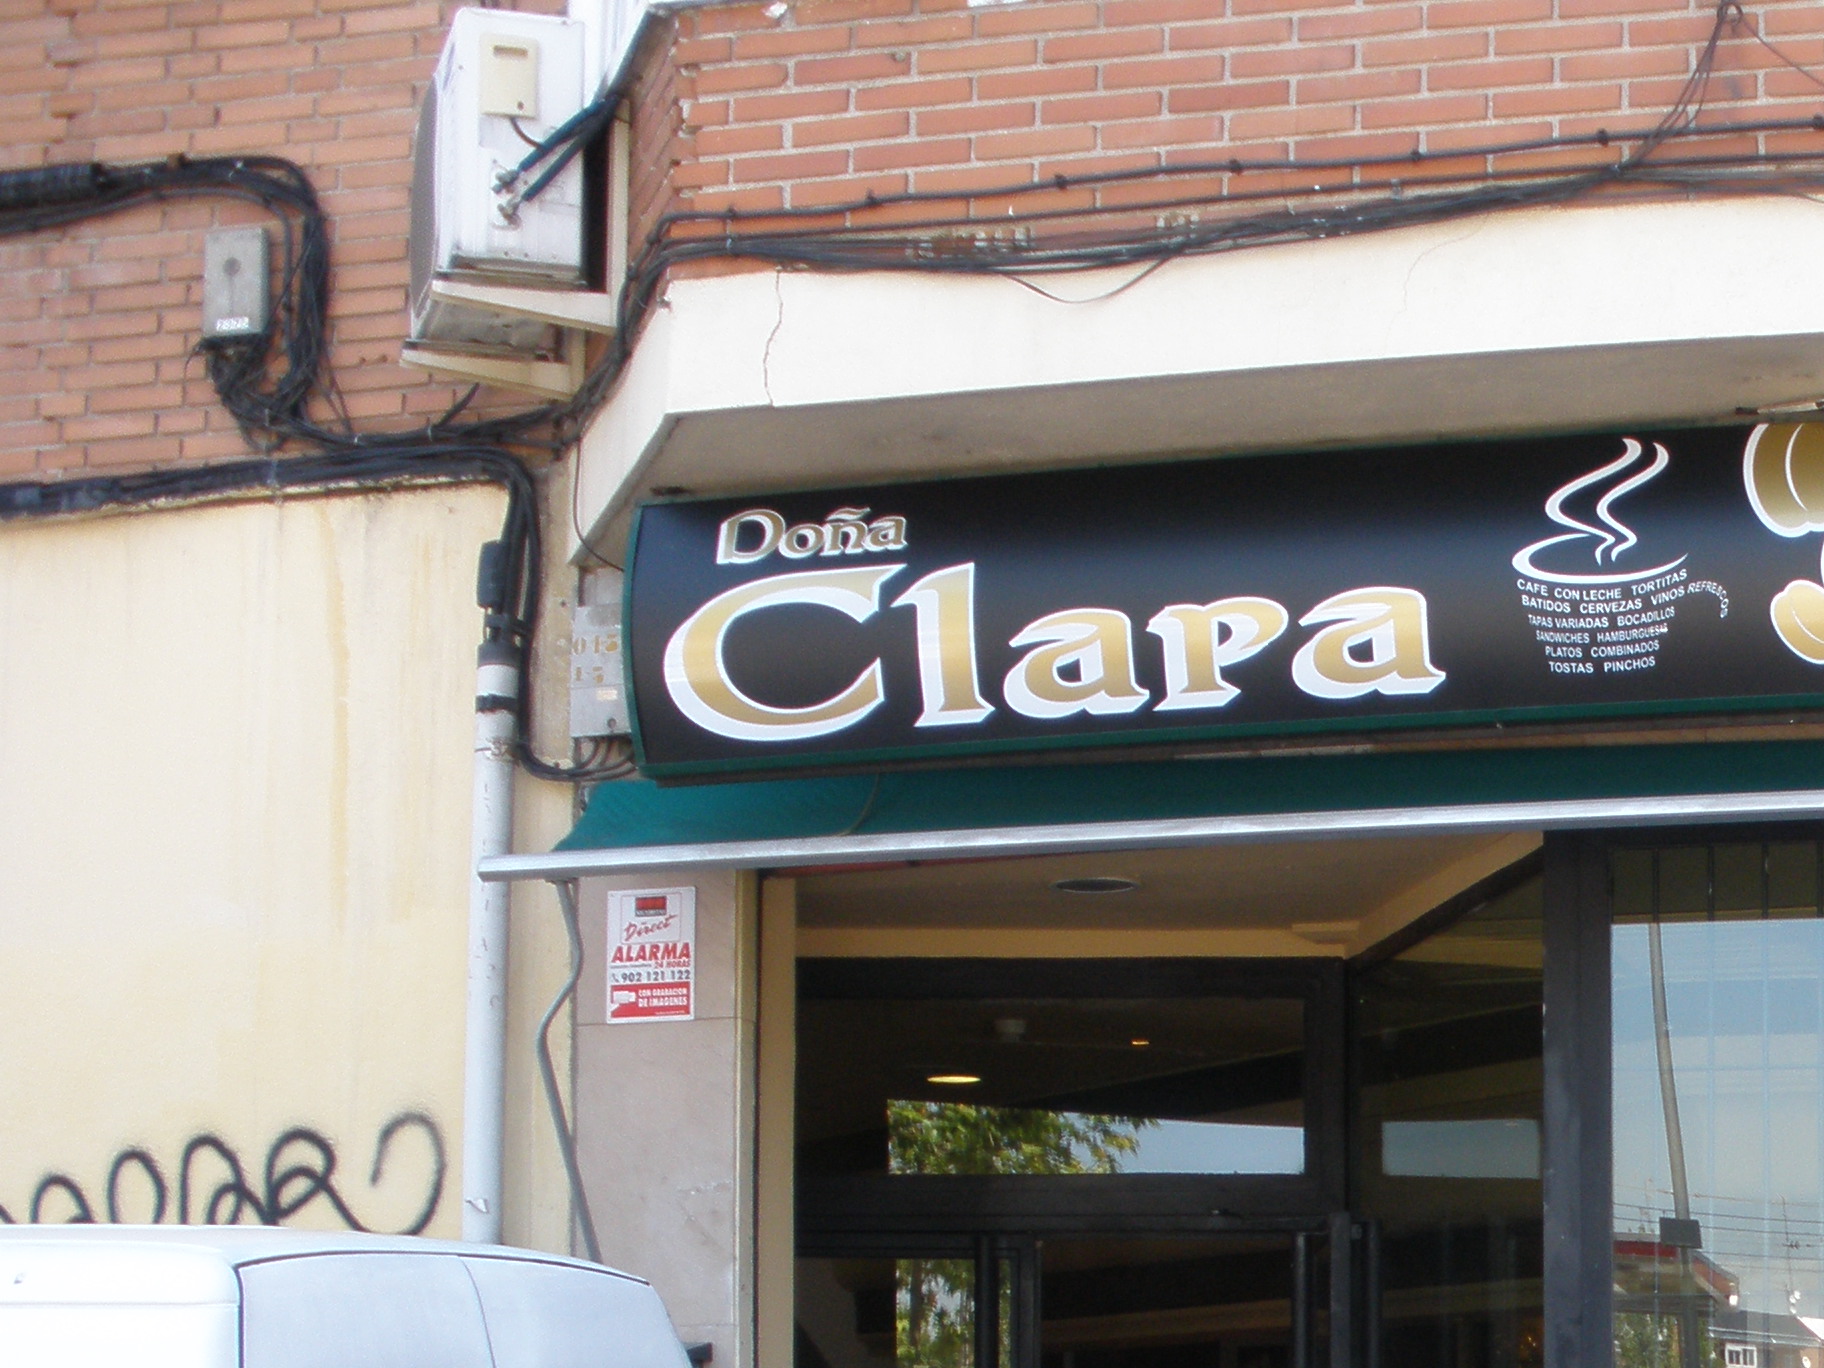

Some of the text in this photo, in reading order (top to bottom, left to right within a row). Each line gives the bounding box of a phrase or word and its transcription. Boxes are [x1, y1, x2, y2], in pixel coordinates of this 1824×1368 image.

[714, 507, 908, 566] Doña
[1517, 568, 1688, 601] CAFE CON LECHE TORTITAS
[1521, 580, 1730, 619] BATIDOS CERVEZAS VINOS REFRESCOS
[1528, 606, 1676, 629] TAPAS VARIADAS BOCADILLOS
[1535, 622, 1669, 644] SANDWICHES HAMBURGUESAS
[1545, 639, 1660, 659] PLATOS COMBINADOS
[1549, 656, 1656, 674] TOSTAS PINCHOS
[624, 913, 679, 942] Direct
[611, 942, 691, 963] ALARMA
[621, 969, 691, 983] 902 121 122
